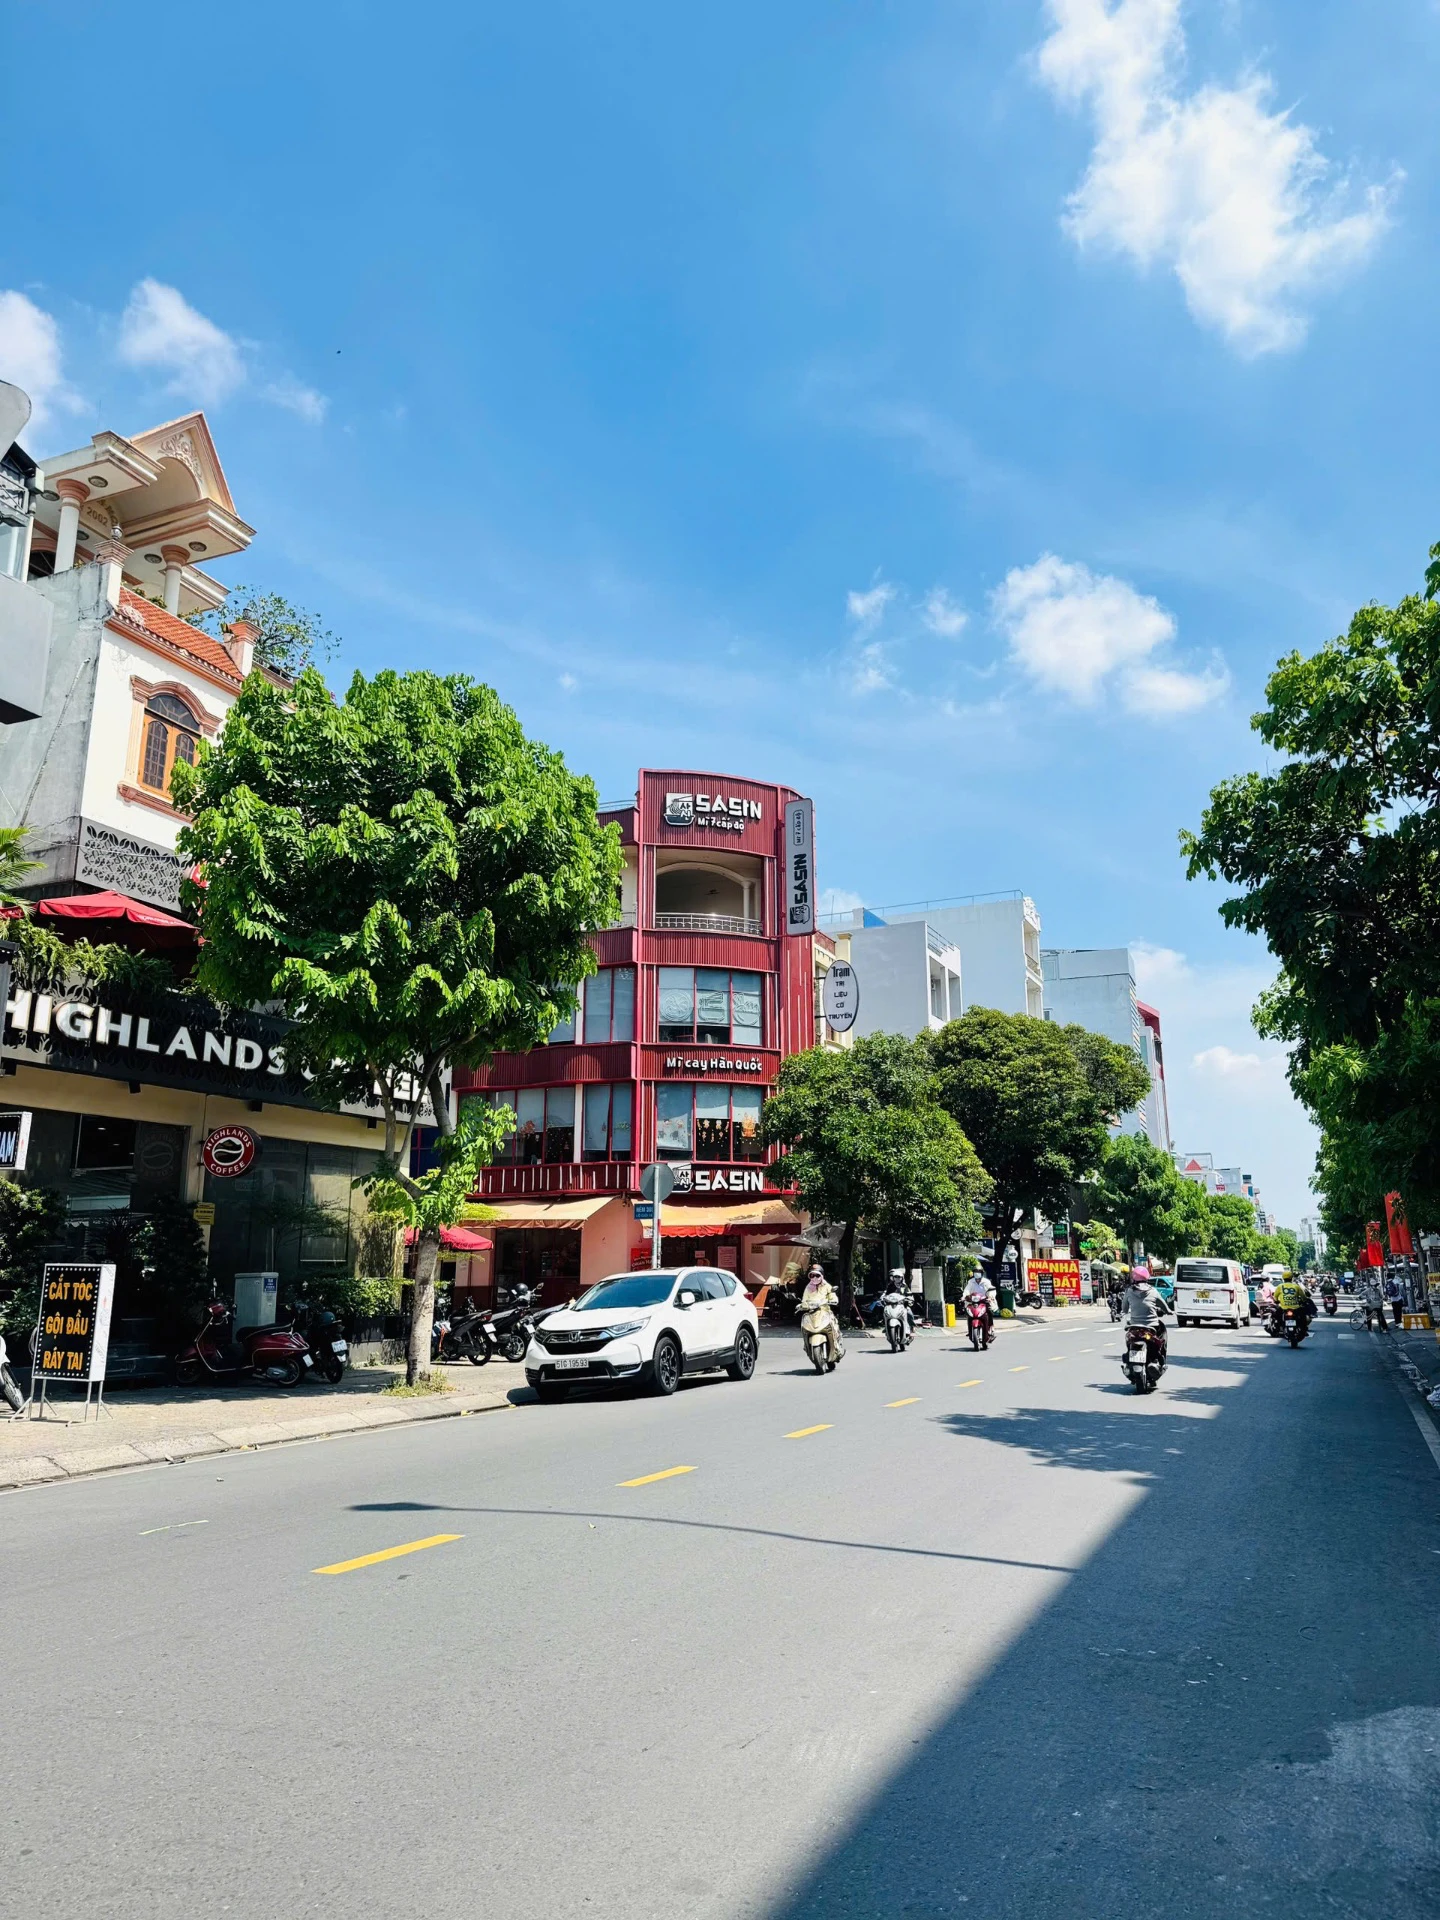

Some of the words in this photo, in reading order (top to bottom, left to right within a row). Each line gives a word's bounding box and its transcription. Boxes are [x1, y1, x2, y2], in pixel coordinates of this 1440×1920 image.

[86, 506, 108, 527] 2002
[695, 793, 762, 819] SASIN
[698, 816, 710, 826] Mì
[710, 816, 716, 826] 7
[716, 816, 732, 830] cấp
[734, 819, 744, 833] độ
[794, 854, 808, 904] SASIN
[5, 988, 288, 1076] HIGHLANDS
[666, 1056, 683, 1068] Mì
[685, 1060, 708, 1070] cay
[710, 1056, 733, 1068] Hàn
[735, 1057, 762, 1070] Quốc
[206, 1128, 252, 1150] HIGHLANDS
[210, 1160, 246, 1174] COFFEE
[695, 1170, 764, 1191] SASIN
[1028, 1260, 1048, 1269] NHÀ
[1048, 1260, 1078, 1273] NHÀ
[48, 1273, 70, 1300] CẮT
[72, 1278, 92, 1300] TÓC
[1053, 1274, 1078, 1288] ĐẤT
[46, 1312, 64, 1340] GỘI
[42, 1346, 64, 1370] RÁY
[67, 1352, 83, 1370] TAI
